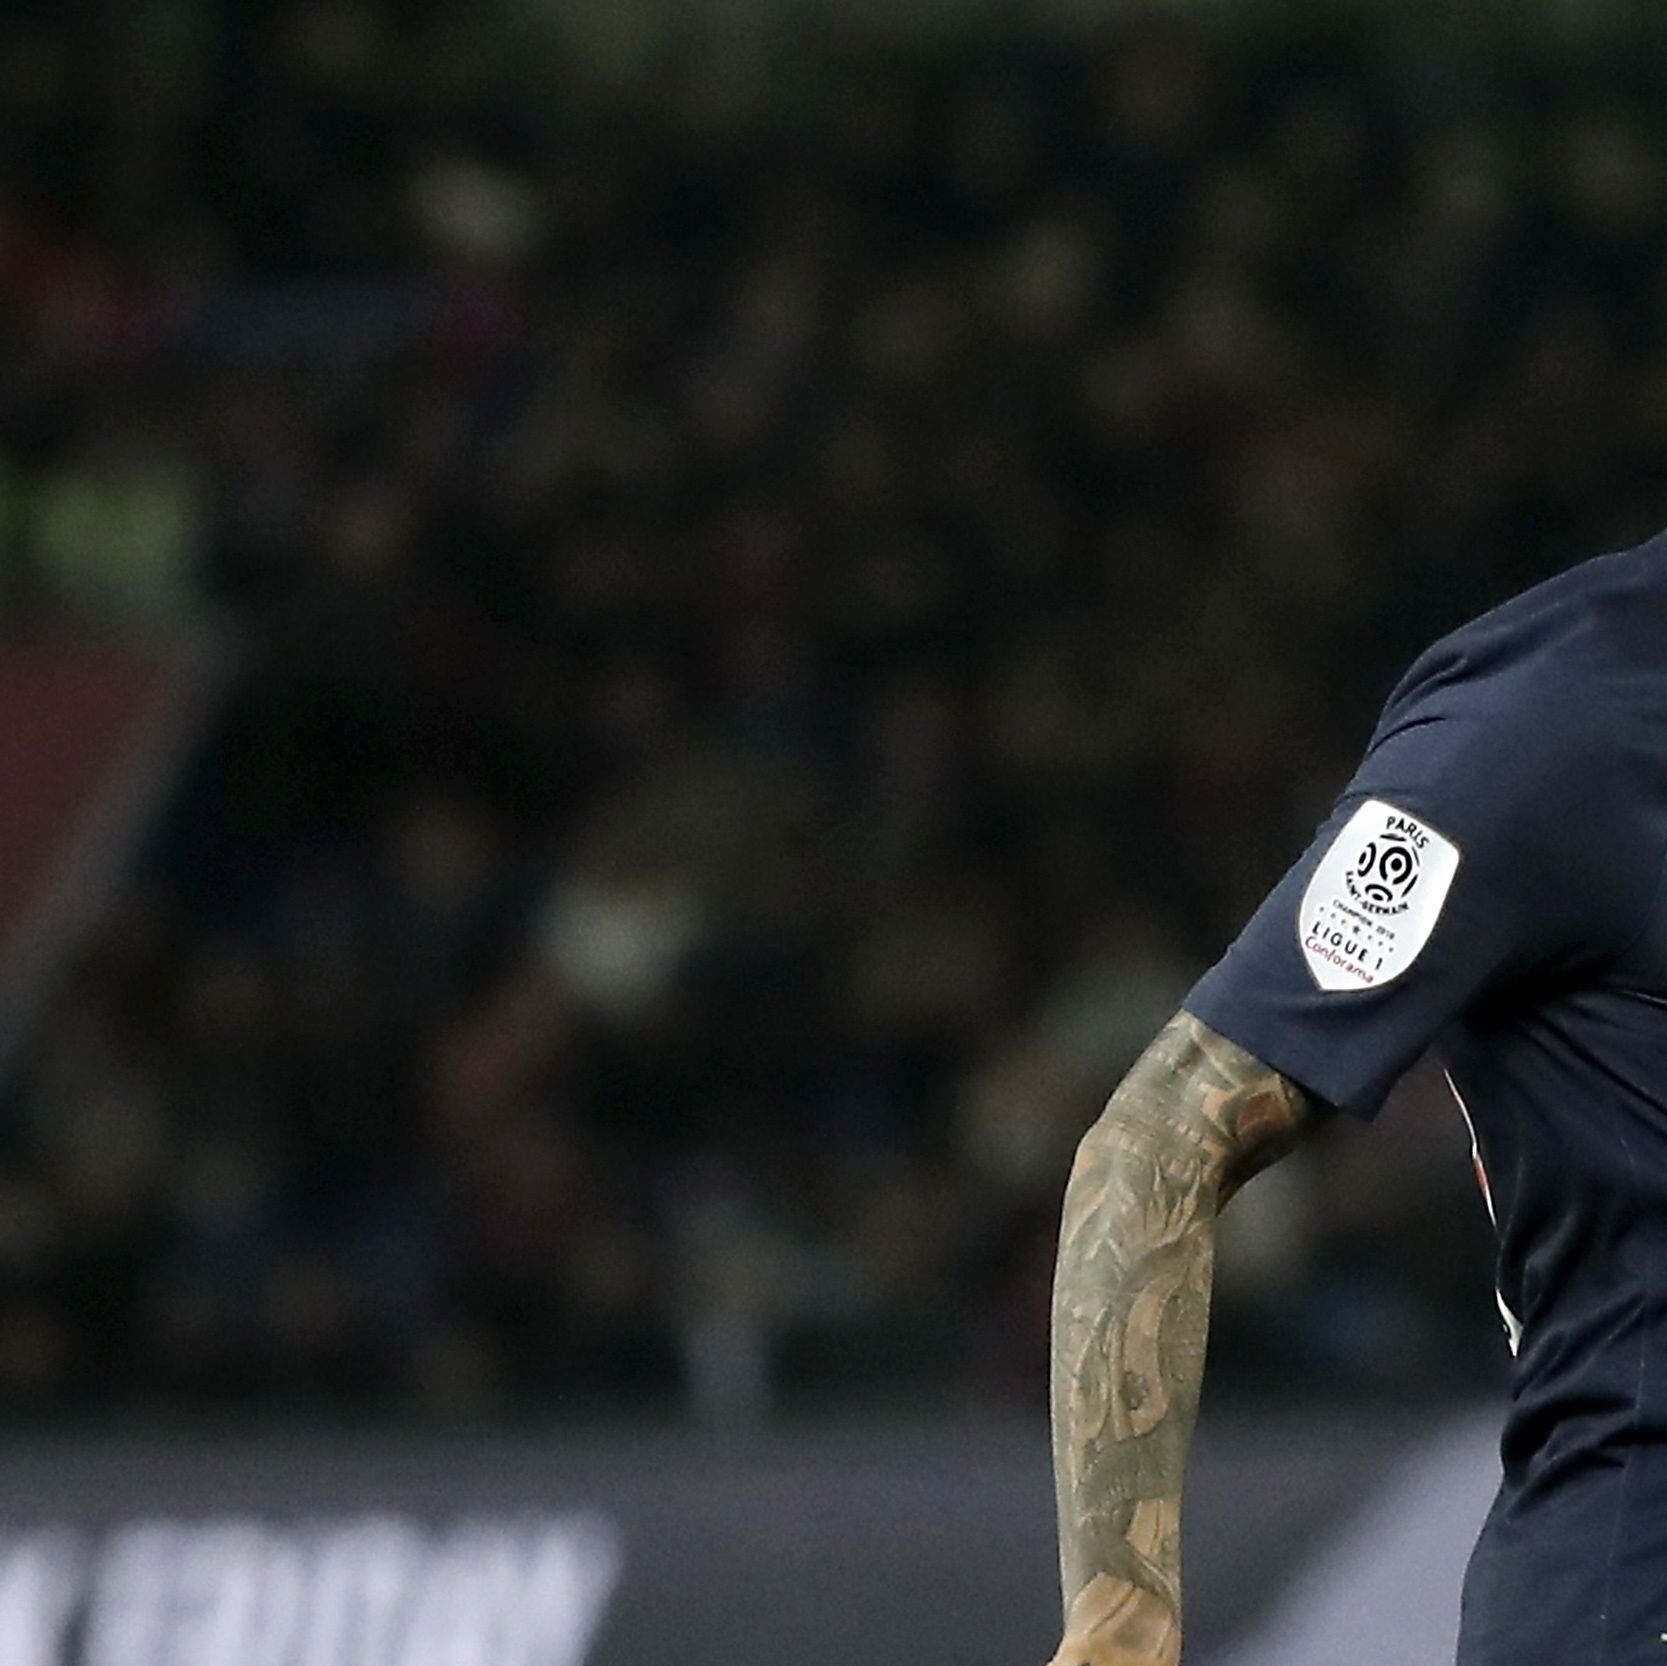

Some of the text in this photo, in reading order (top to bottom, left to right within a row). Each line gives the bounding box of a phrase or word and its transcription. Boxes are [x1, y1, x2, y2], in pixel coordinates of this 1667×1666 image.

[1386, 816, 1430, 849] PARIS
[1305, 936, 1374, 983] Conforama
[1312, 921, 1383, 970] LIGUE 1
